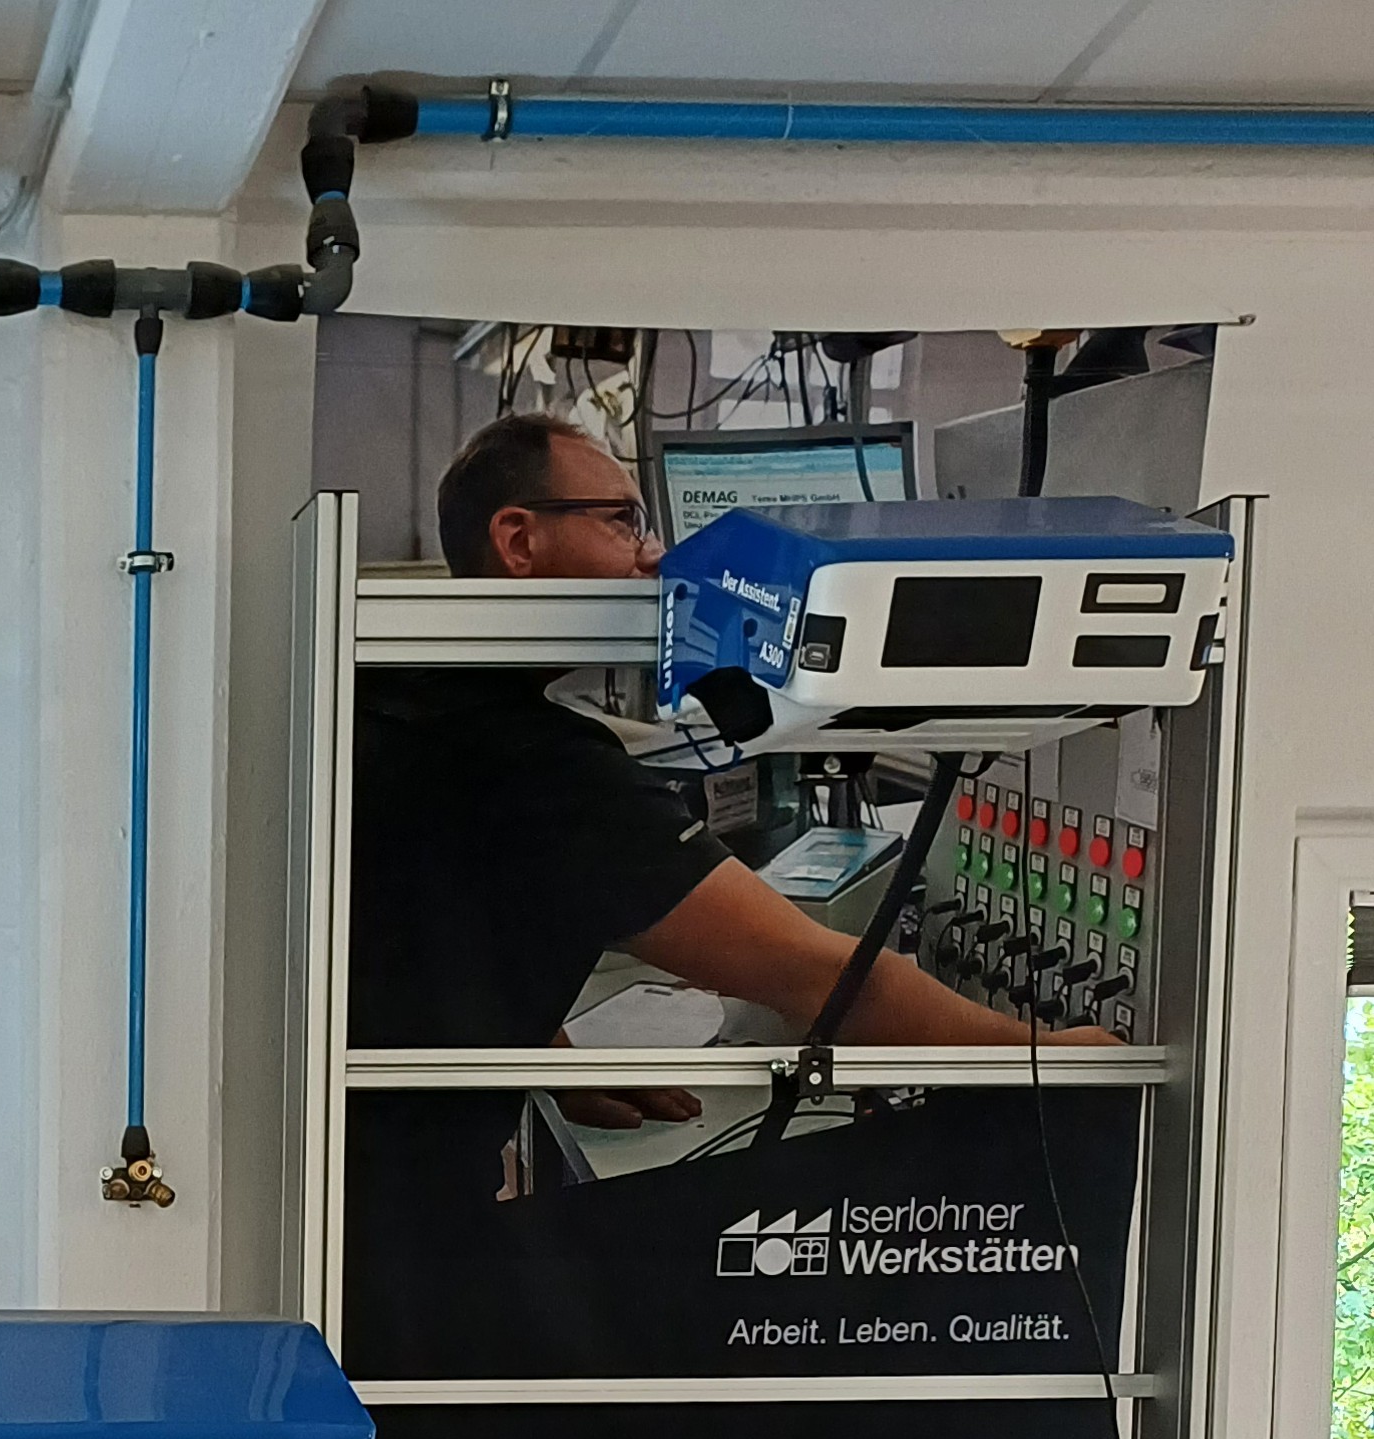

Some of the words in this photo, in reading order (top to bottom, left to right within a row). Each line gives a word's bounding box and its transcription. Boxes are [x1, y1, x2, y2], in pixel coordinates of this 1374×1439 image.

[683, 491, 738, 503] DEMAG
[722, 569, 738, 591] Der
[737, 577, 781, 612] Assistent.
[759, 641, 785, 669] A300
[841, 1195, 1024, 1233] Iserlohner
[839, 1238, 1079, 1275] Werkstätten
[727, 1318, 826, 1345] Arbeit.
[839, 1317, 937, 1344] Leben.
[949, 1313, 1070, 1343] Qualität.
